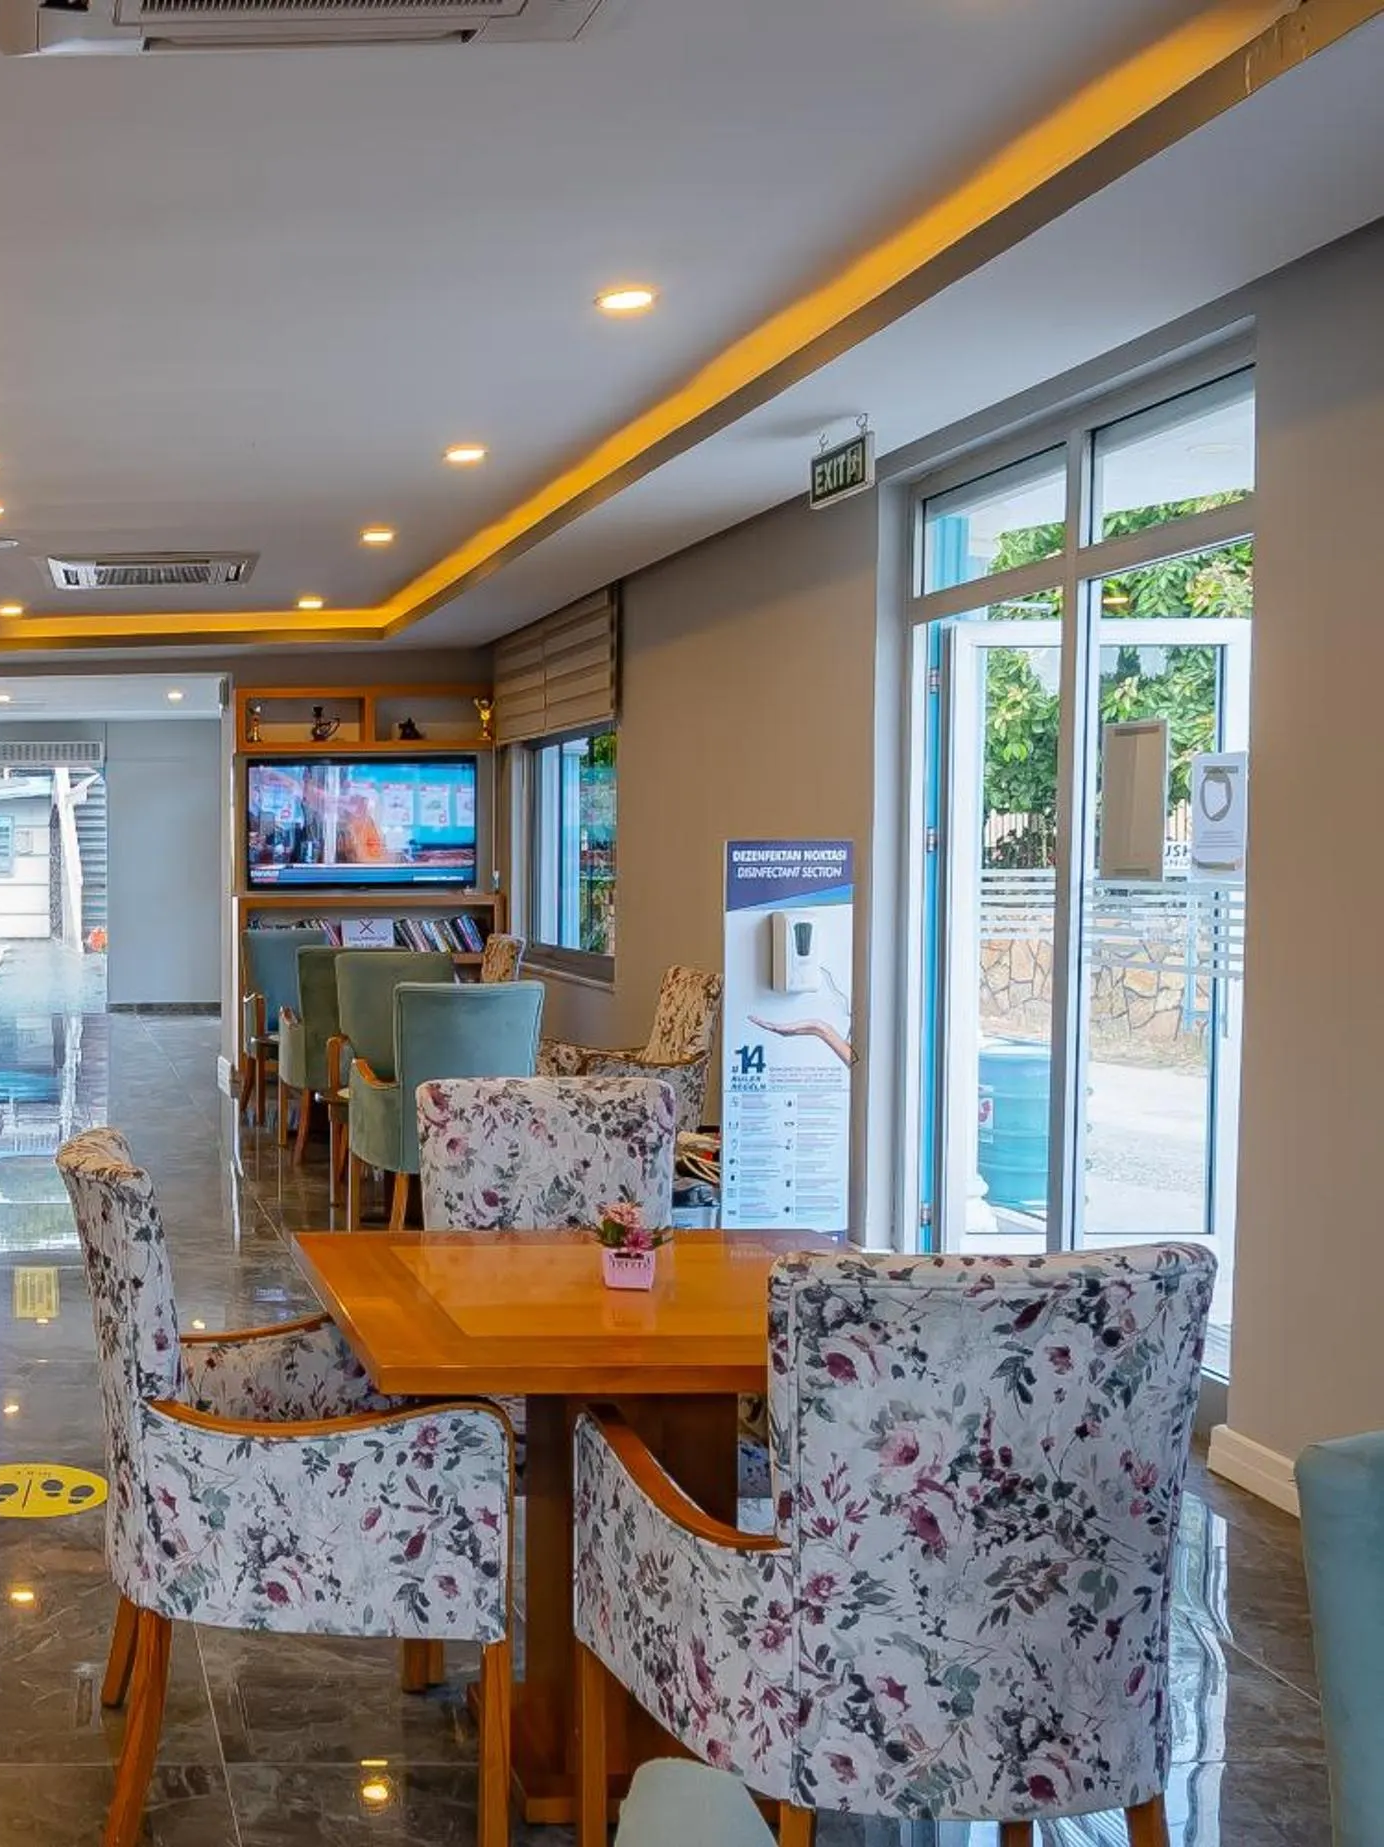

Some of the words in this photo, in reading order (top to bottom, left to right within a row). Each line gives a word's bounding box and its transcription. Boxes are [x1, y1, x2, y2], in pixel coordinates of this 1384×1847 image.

[815, 453, 846, 495] EXIT
[737, 866, 800, 878] DISINFECTANT
[801, 866, 842, 878] SECTION
[734, 1044, 766, 1074] 14
